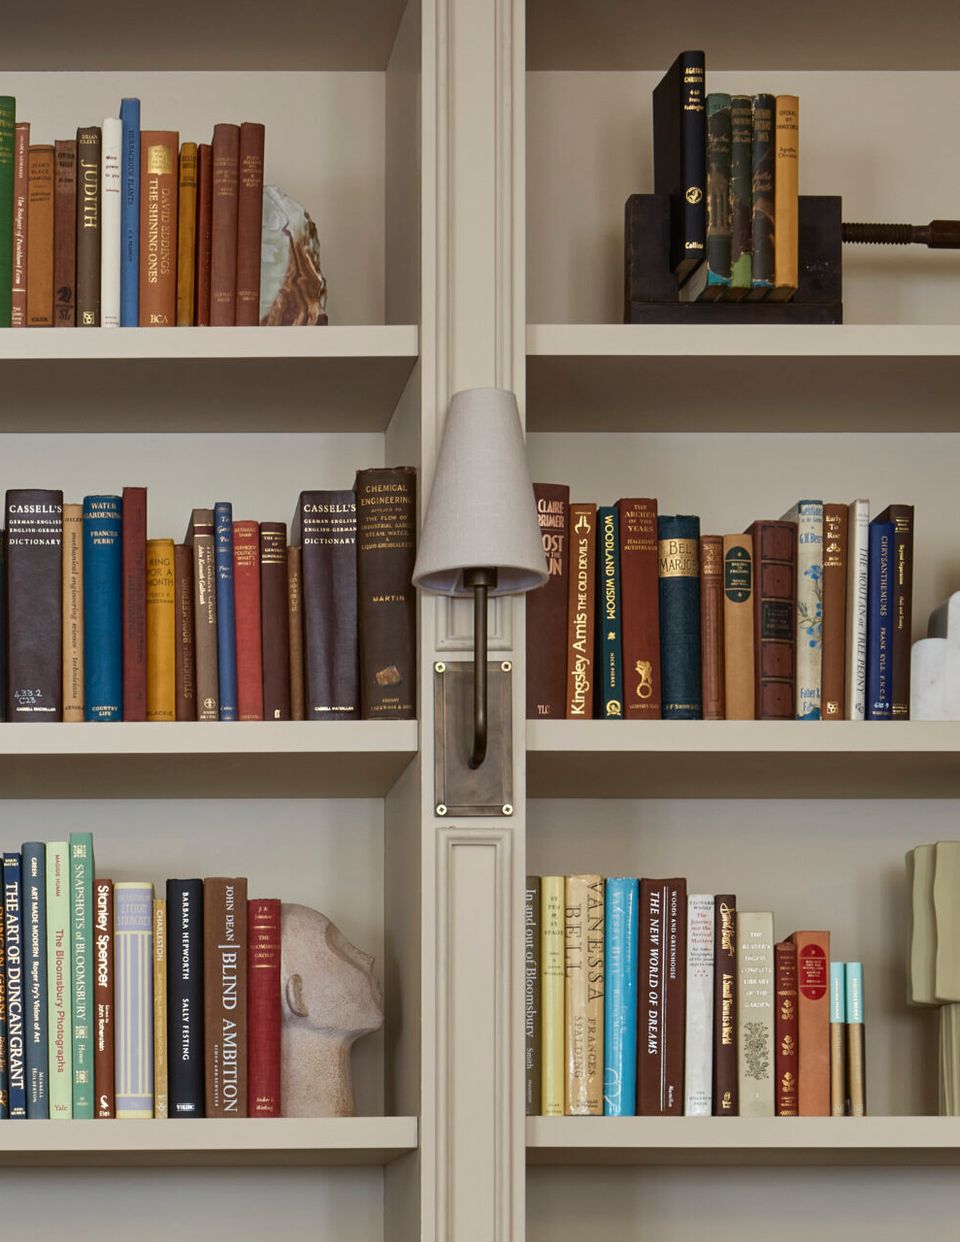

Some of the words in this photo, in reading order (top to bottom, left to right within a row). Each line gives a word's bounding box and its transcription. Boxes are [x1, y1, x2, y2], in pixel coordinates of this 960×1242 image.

[81, 160, 97, 229] JUDITH
[149, 178, 158, 201] THE
[160, 188, 169, 223] DAVID
[149, 203, 158, 251] SHINING
[148, 254, 157, 283] ONES
[160, 226, 169, 274] EDDINGS
[9, 505, 62, 513] CASSELL'S
[304, 504, 356, 513] CASSELL'S
[71, 532, 79, 574] mechanical
[579, 539, 588, 573] DEVILS
[605, 515, 615, 576] WOODLAND
[579, 574, 587, 591] OLD
[880, 536, 888, 616] CHRYSANTHEMUMS
[70, 576, 78, 620] engineering
[578, 592, 587, 611] THE
[606, 579, 616, 619] WISDOM
[573, 613, 588, 651] Amis
[571, 654, 590, 714] Kingsley
[5, 882, 17, 912] THE
[31, 902, 39, 923] MADE
[75, 864, 85, 930] SNAPSHOTS
[96, 885, 109, 931] Stanley
[225, 885, 234, 911] JOHN
[650, 892, 659, 914] THE
[7, 914, 19, 944] ART
[55, 929, 64, 948] The
[76, 932, 85, 941] of
[226, 914, 234, 941] DEAN
[565, 904, 582, 978] BELL
[587, 880, 603, 1003] VANESSA
[650, 919, 659, 945] NEW
[7, 946, 19, 963] OF
[31, 961, 39, 981] Roger
[97, 935, 109, 988] Spencer
[649, 948, 659, 988] WORLD
[54, 950, 64, 1008] Bloomsbury
[76, 943, 87, 1021] BLOOMSBURY
[222, 952, 237, 1010] BLIND
[649, 992, 658, 1006] OF
[8, 967, 20, 1035] DUNCAN
[182, 998, 190, 1022] SALLY
[55, 1011, 65, 1073] Photographs
[182, 1025, 190, 1061] FESTING
[574, 1016, 582, 1078] SPALDING
[588, 1017, 596, 1076] FRANCES
[648, 1010, 658, 1054] DREAMS
[10, 1036, 23, 1090] GRANT
[223, 1018, 238, 1112] AMBITION
